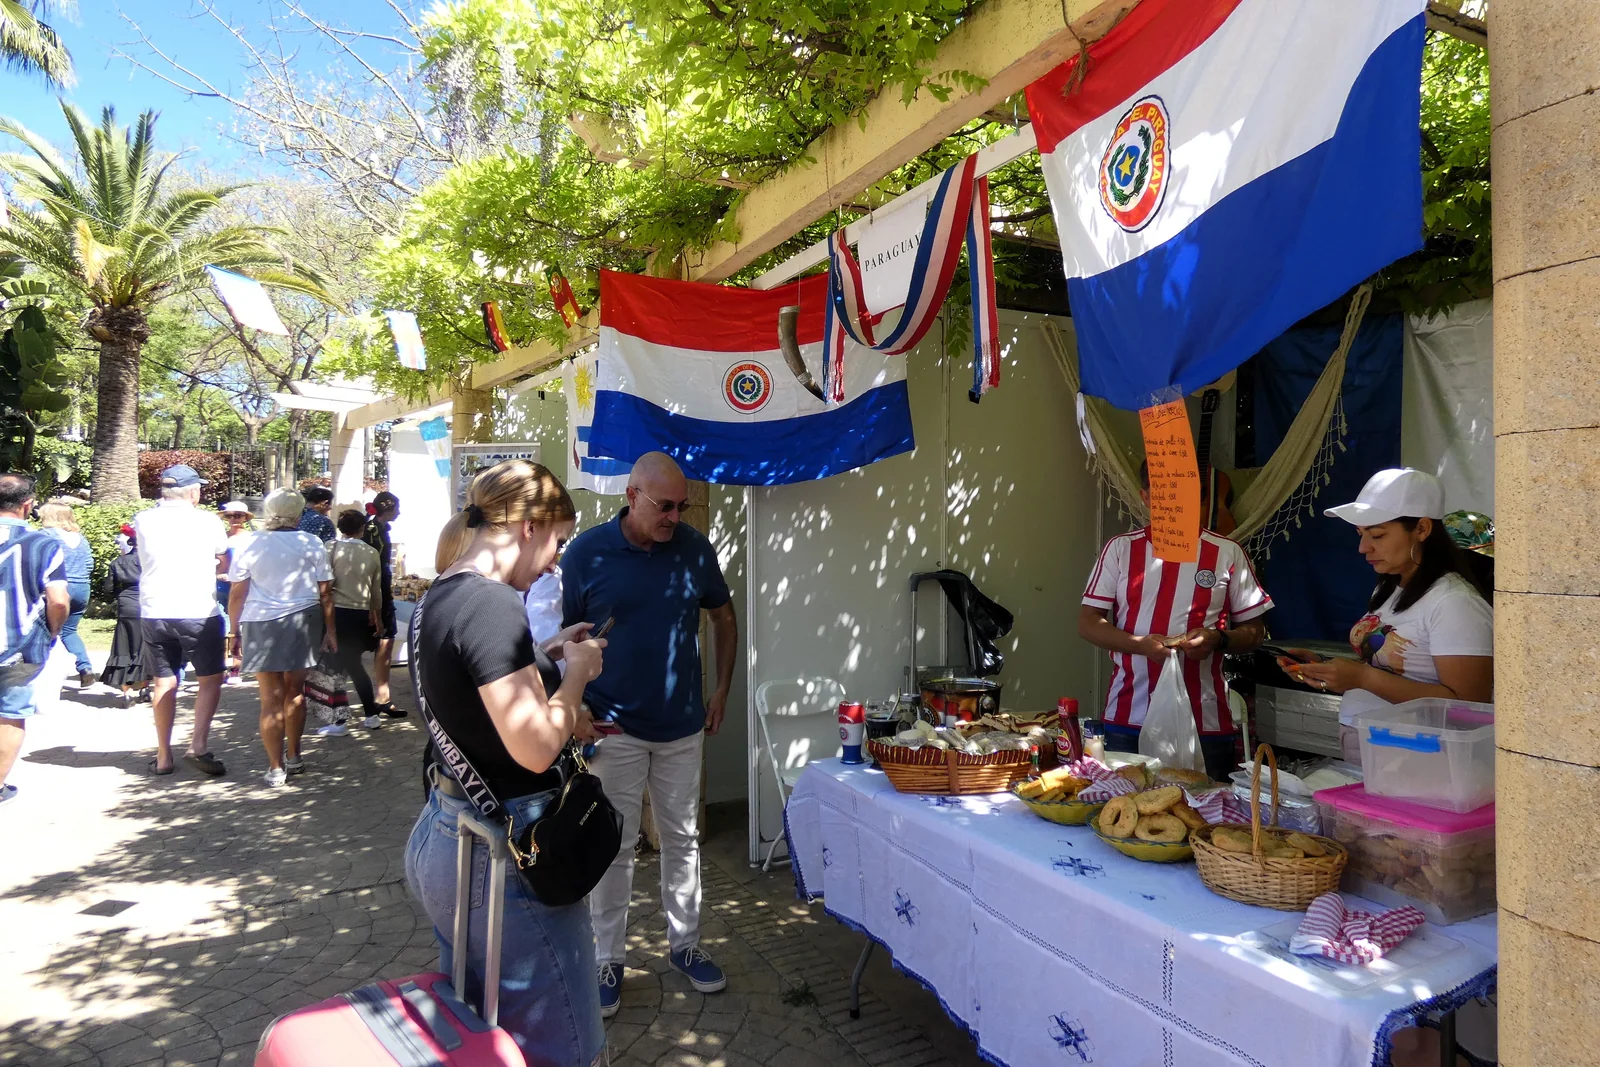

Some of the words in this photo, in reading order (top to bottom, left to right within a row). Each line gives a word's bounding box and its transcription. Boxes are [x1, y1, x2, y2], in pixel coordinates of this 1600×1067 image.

[1146, 107, 1166, 196] PARAGUAY
[864, 231, 922, 273] PARAGUAY
[429, 719, 469, 780] BIMBA
[463, 772, 481, 790] Y
